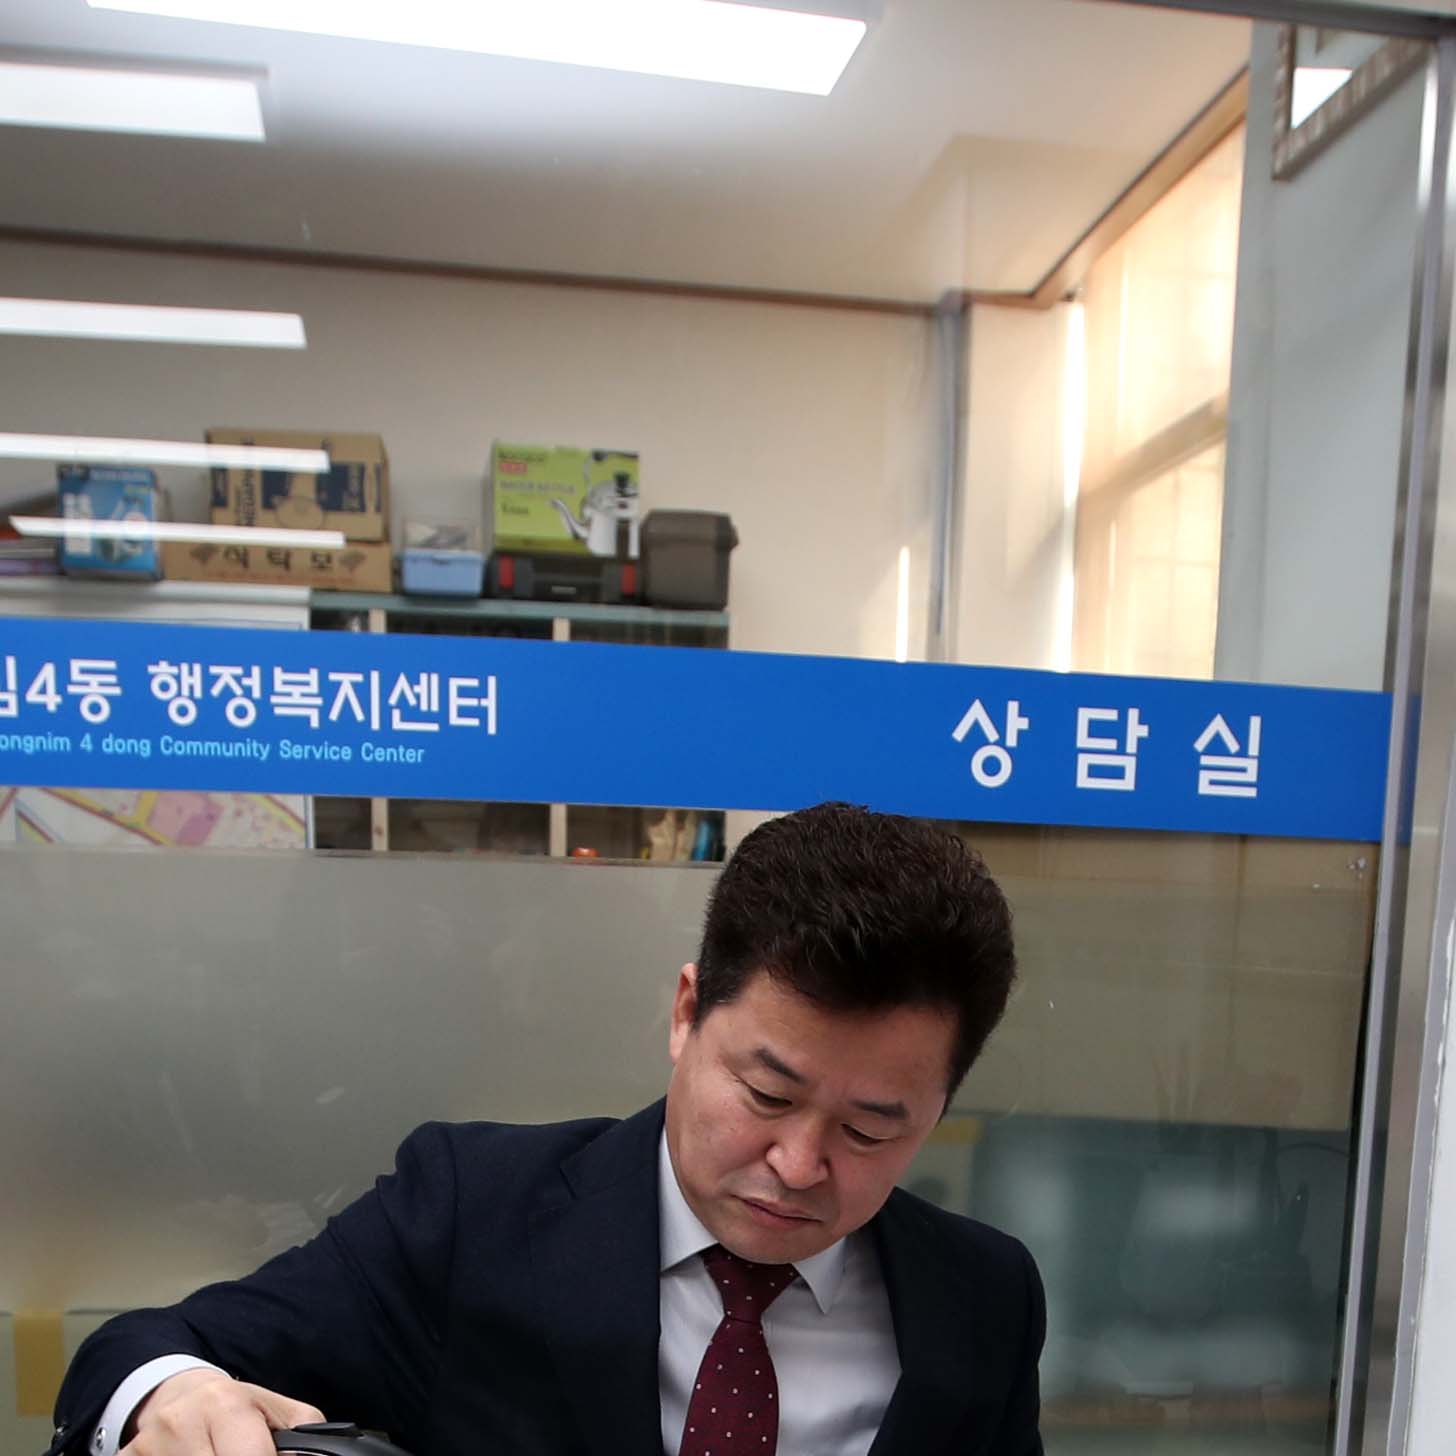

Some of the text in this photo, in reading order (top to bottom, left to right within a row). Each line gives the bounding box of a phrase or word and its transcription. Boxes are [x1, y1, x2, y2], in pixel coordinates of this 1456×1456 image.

[148, 660, 498, 735] 행정복지센터
[80, 733, 94, 751] 4
[102, 734, 151, 757] dong
[161, 736, 270, 760] Community
[280, 740, 351, 760] Service
[361, 742, 424, 763] Center
[952, 698, 1262, 798] 상담실
